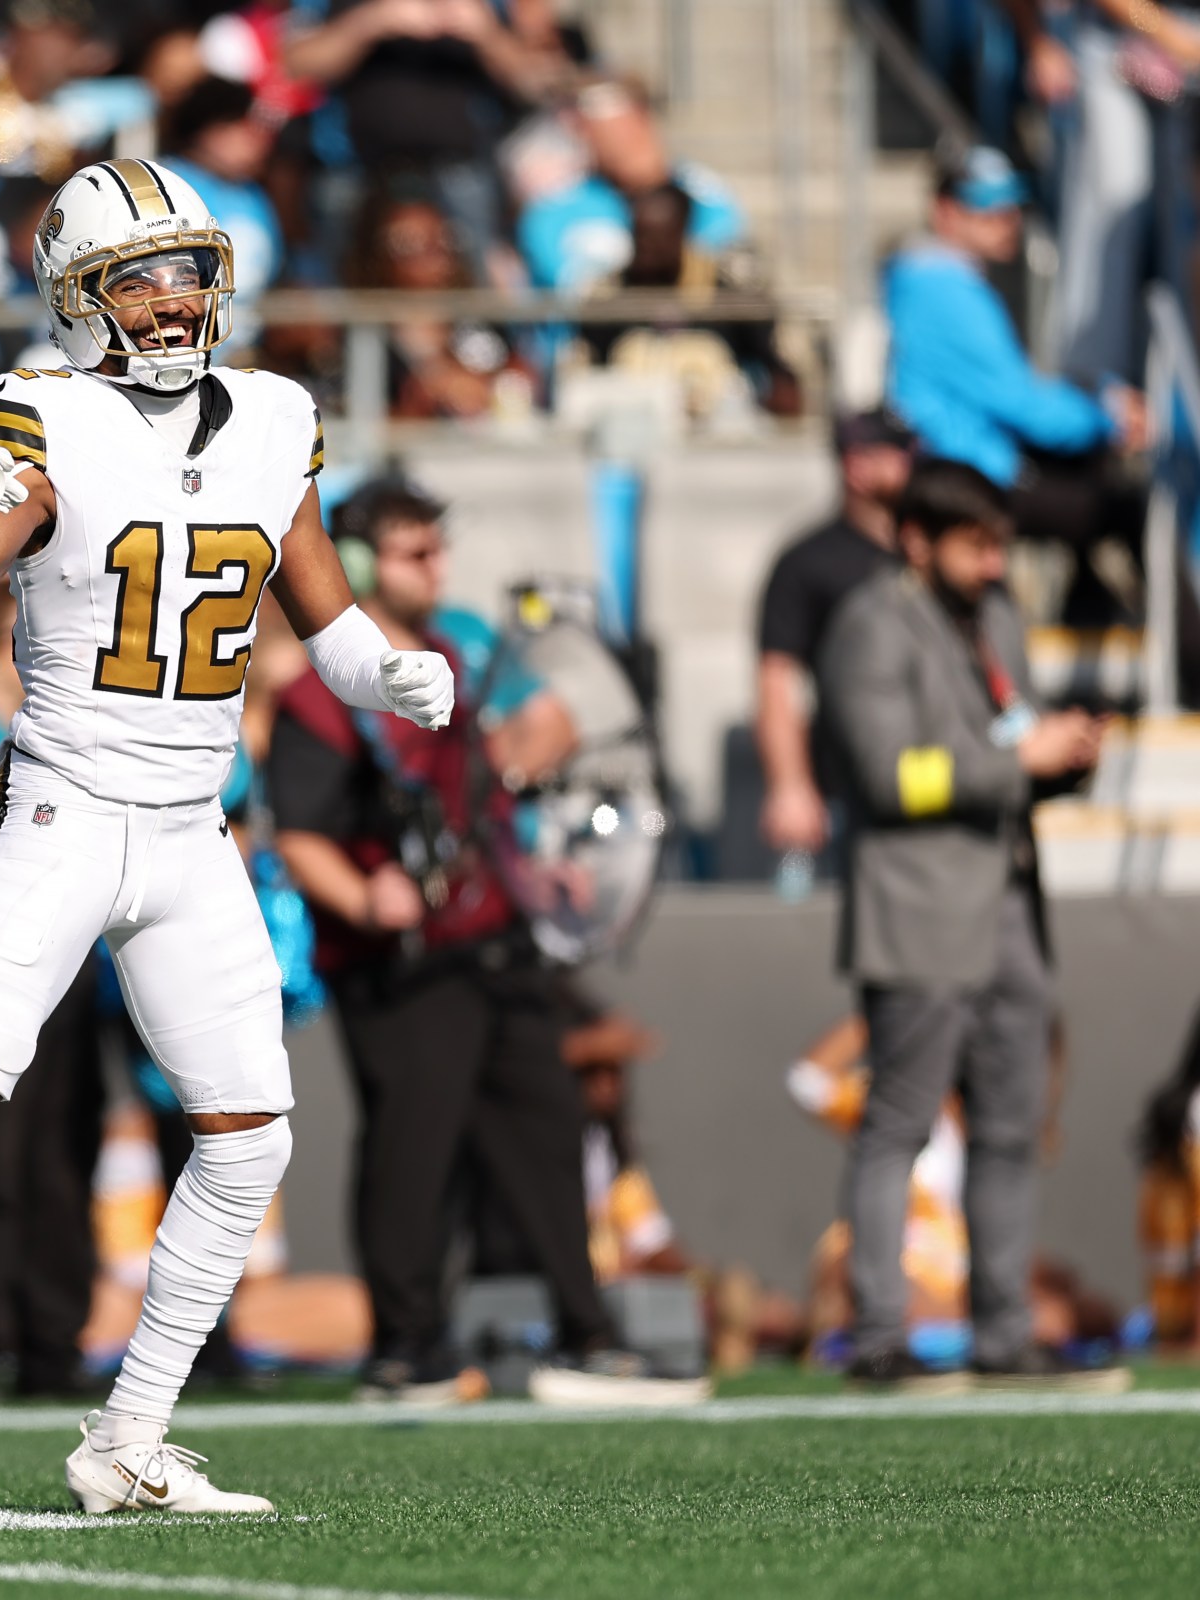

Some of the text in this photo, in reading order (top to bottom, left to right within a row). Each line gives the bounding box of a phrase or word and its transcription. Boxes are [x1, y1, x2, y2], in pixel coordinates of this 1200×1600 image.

[146, 218, 172, 229] SAINTS
[92, 520, 276, 701] 12
[35, 811, 54, 823] NFL
